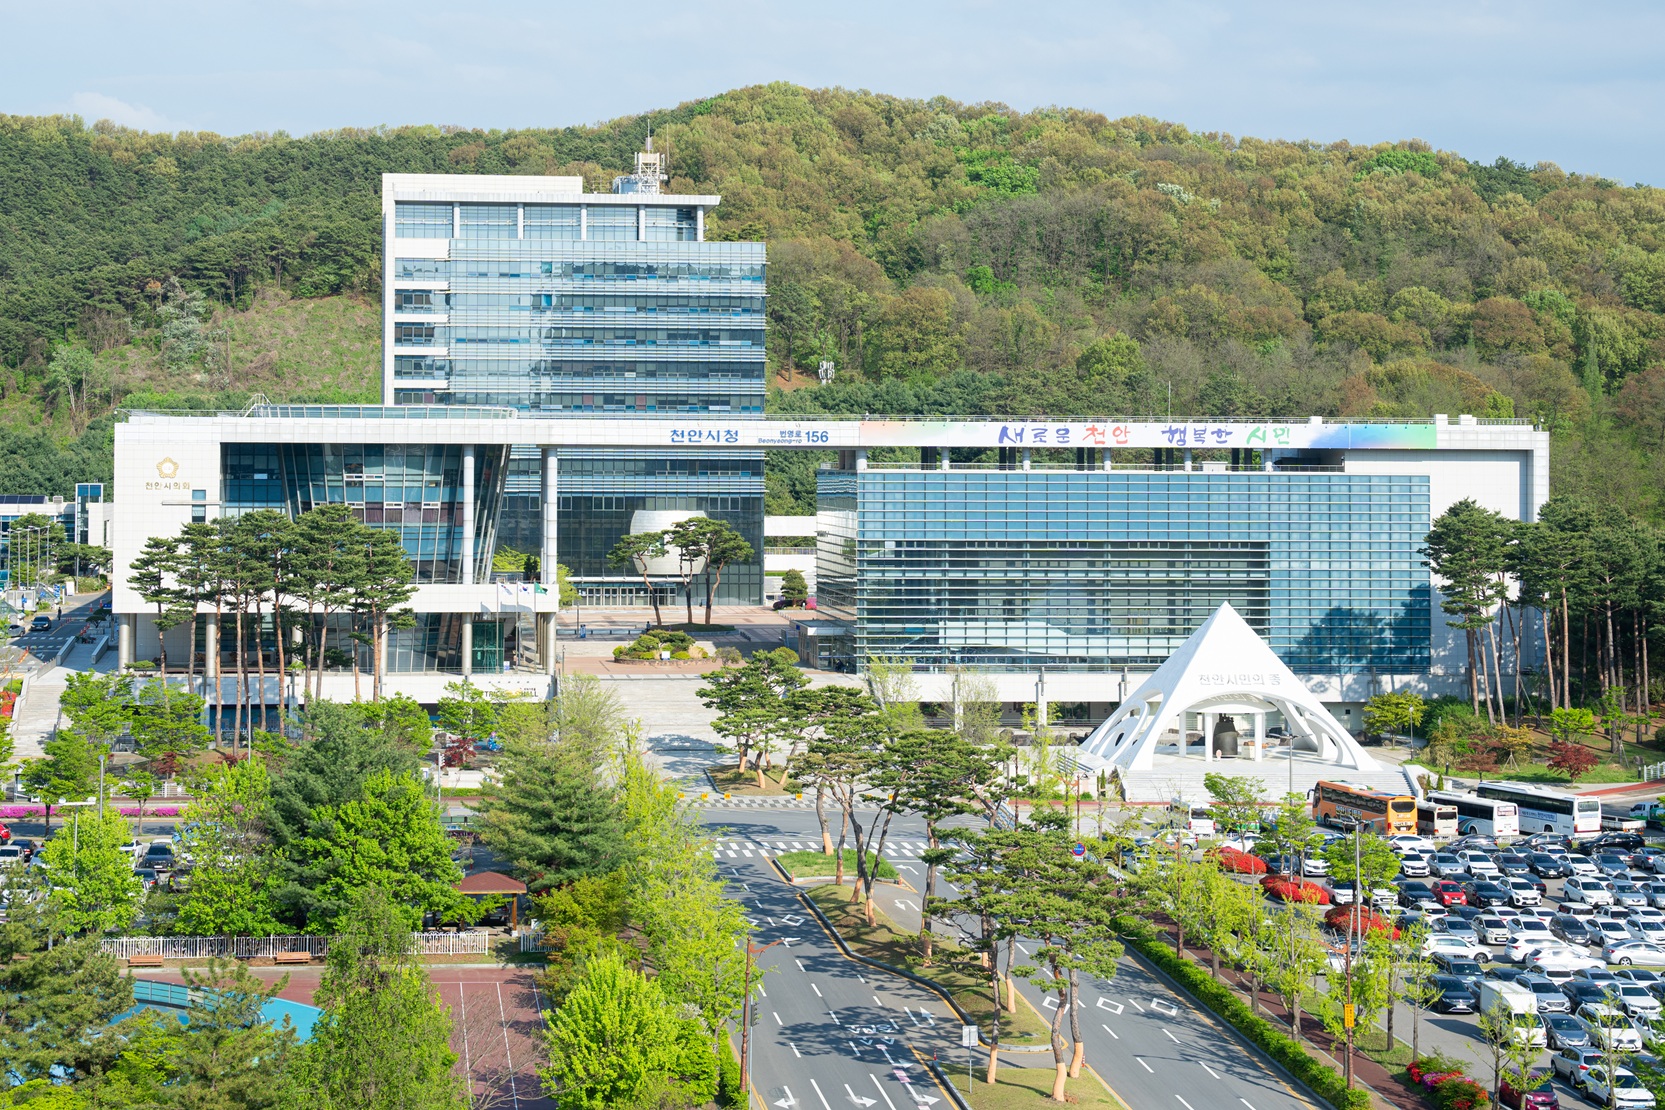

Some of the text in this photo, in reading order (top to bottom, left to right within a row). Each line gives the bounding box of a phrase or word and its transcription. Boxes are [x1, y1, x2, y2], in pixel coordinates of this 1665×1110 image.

[670, 429, 739, 443] 천안시청
[779, 430, 829, 443] 번영로 156
[998, 424, 1290, 446] 새로운 천안 행복한 시민
[145, 482, 190, 490] 천안시의회
[1198, 673, 1281, 686] 천안시민의 종
